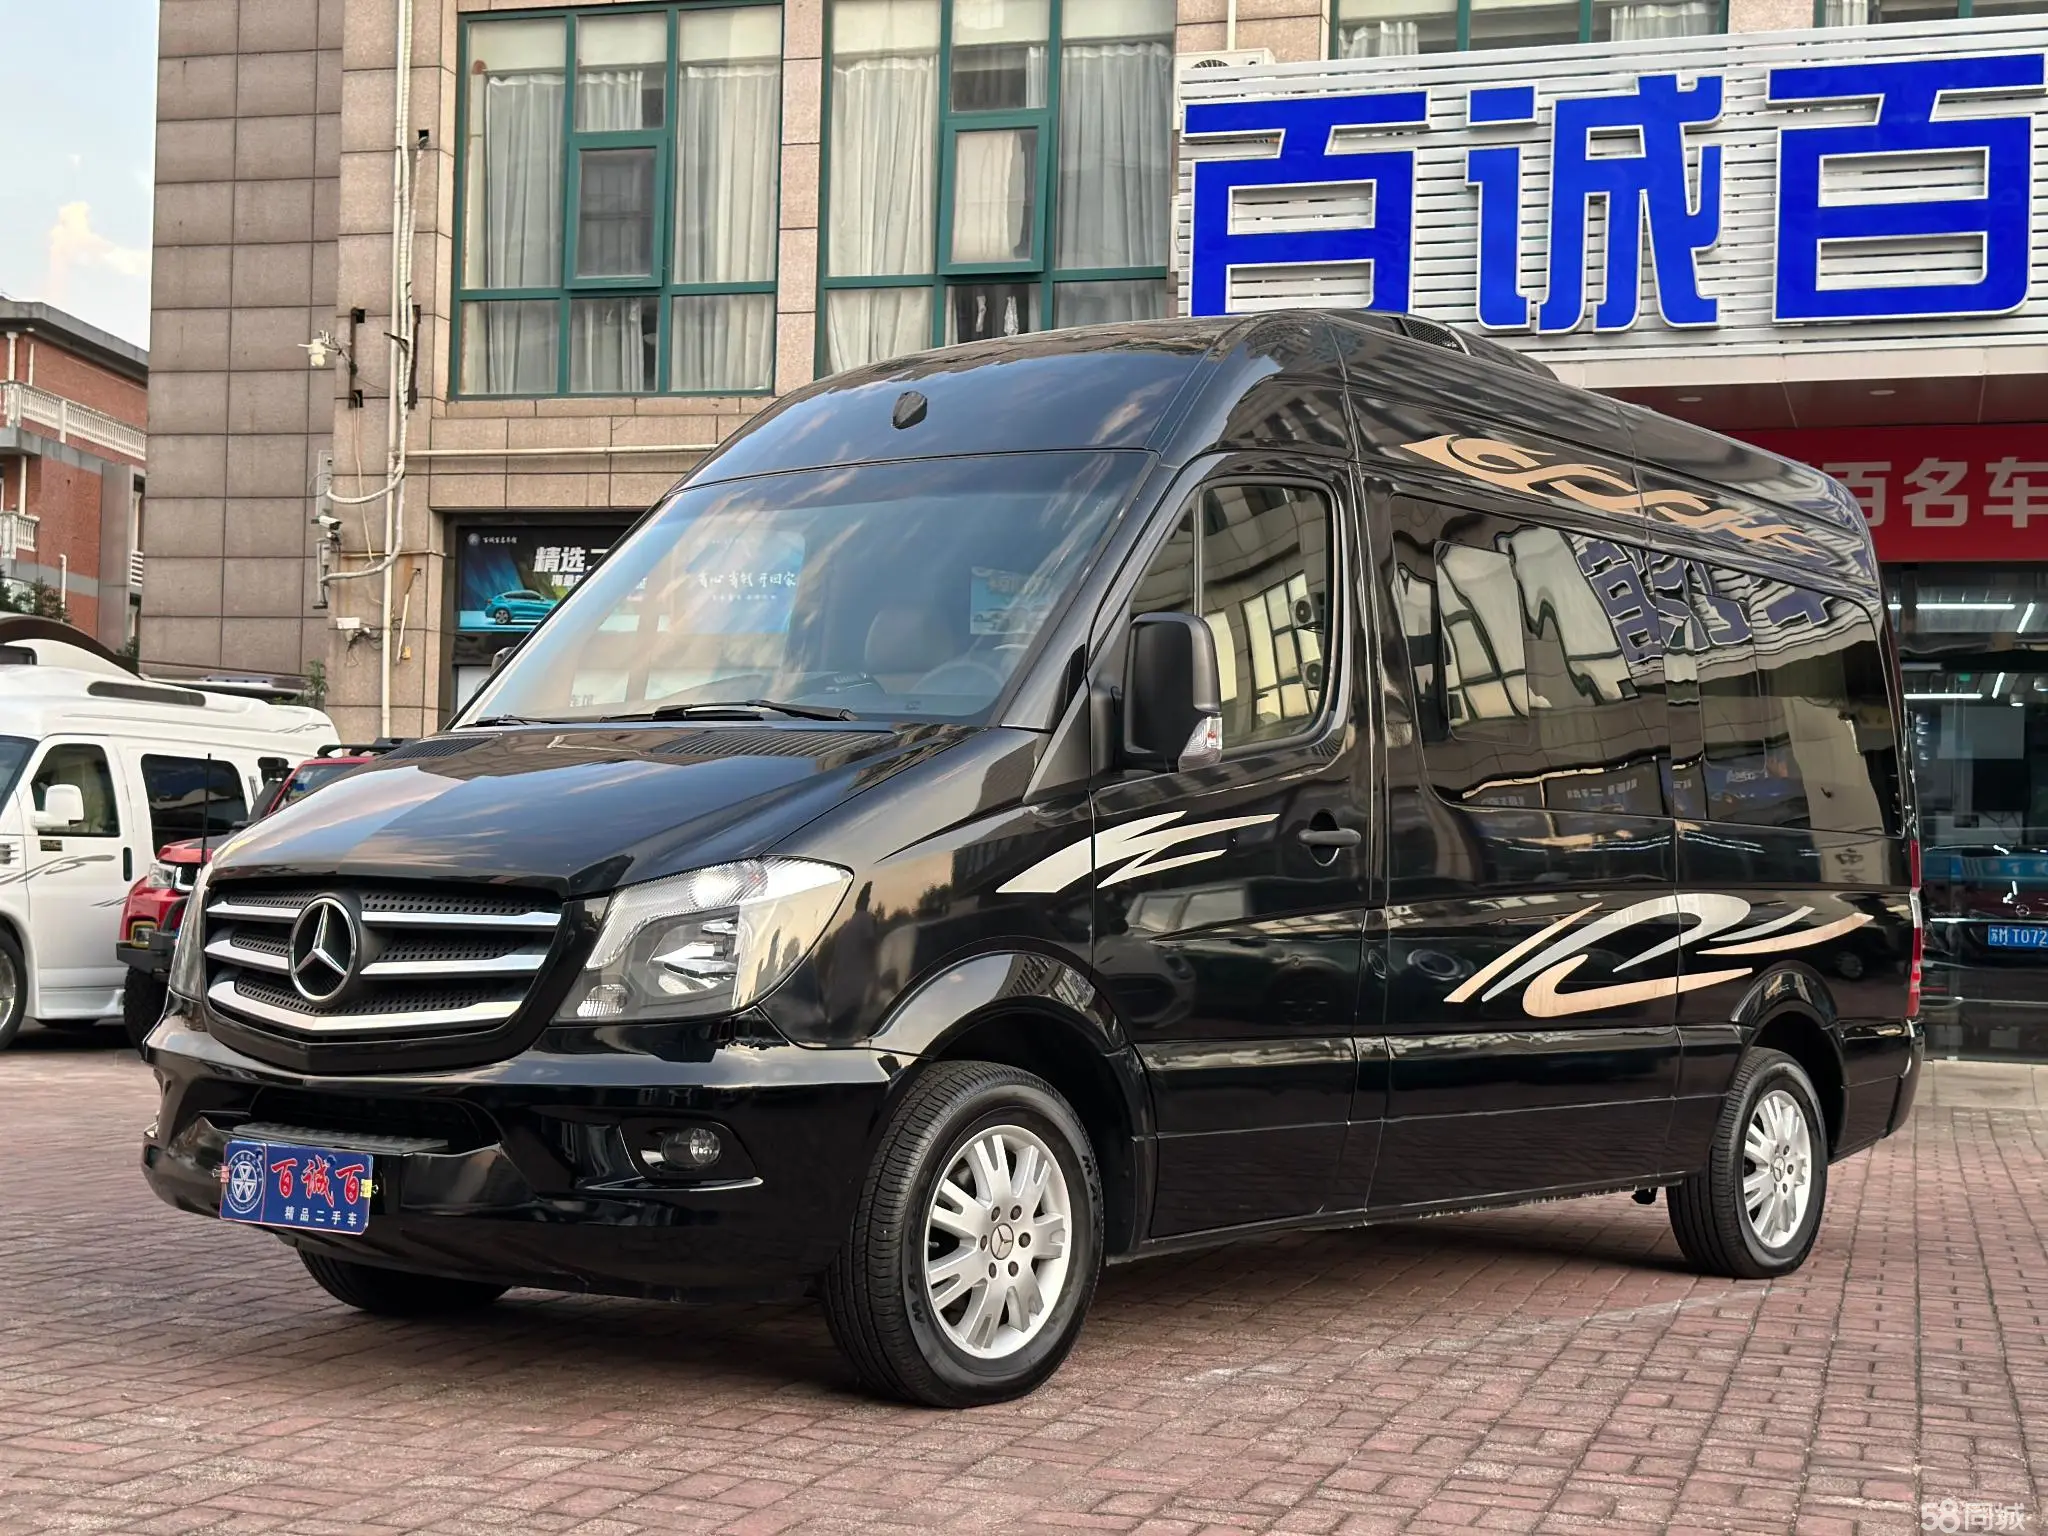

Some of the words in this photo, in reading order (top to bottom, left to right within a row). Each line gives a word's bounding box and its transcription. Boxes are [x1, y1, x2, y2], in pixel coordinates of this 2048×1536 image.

[1184, 53, 2046, 332] 百诚百
[284, 1205, 358, 1227] 精品二手车
